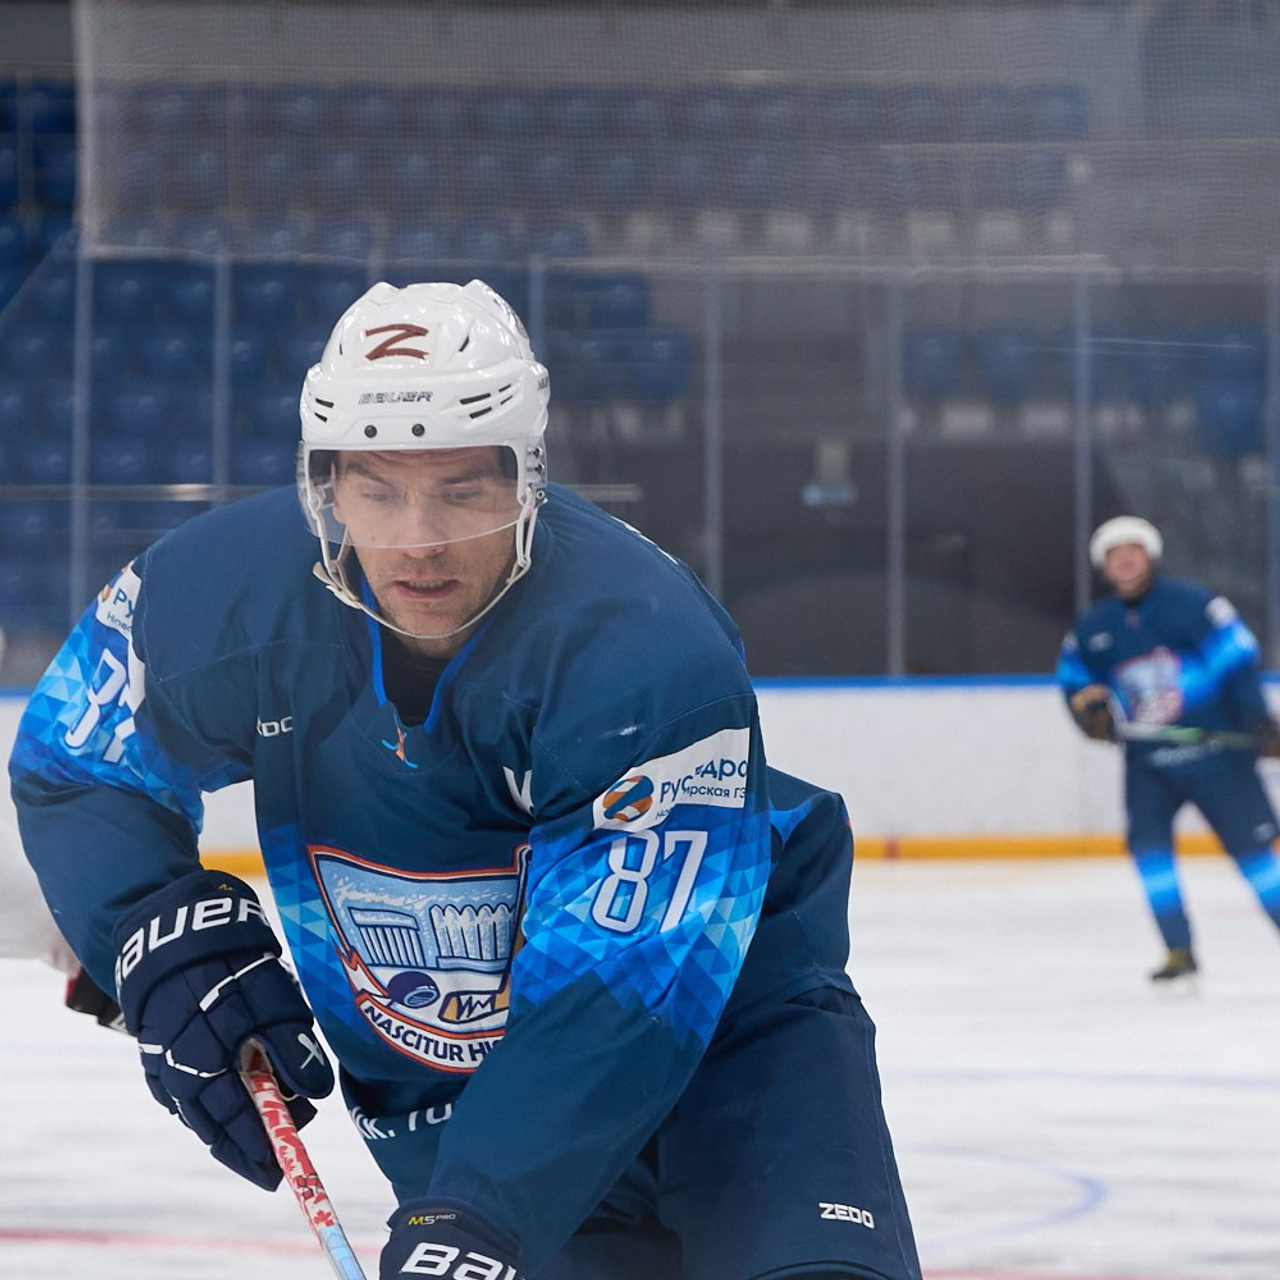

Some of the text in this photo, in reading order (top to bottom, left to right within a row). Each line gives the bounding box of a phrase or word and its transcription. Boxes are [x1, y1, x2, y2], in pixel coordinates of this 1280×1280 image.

[365, 324, 429, 361] Z
[591, 829, 708, 934] 87
[364, 1006, 465, 1062] NASCITUR
[819, 1202, 875, 1229] ZEDO
